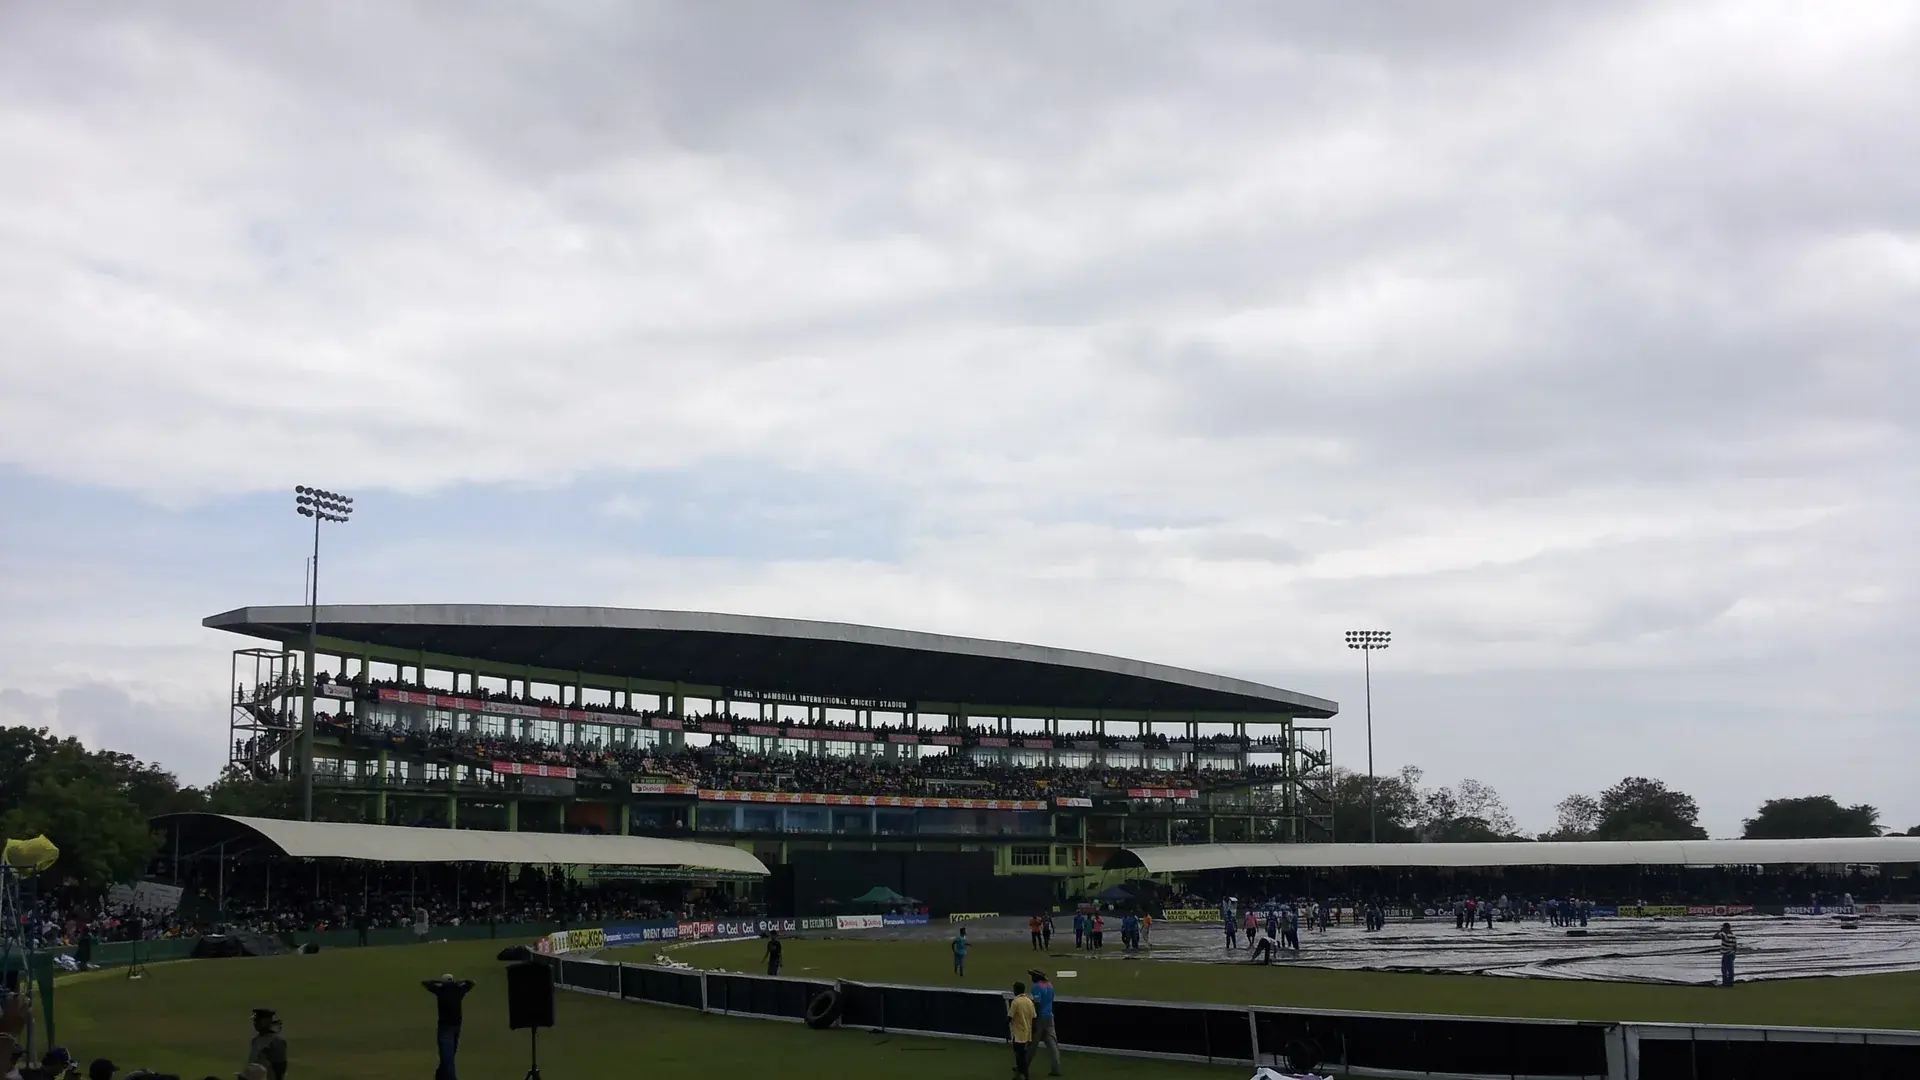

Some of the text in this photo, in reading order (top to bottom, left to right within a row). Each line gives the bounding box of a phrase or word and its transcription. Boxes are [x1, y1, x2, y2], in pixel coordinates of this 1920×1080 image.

[799, 694, 848, 706] INTERNATIONAL
[850, 698, 877, 708] CRICKET
[880, 700, 907, 709] STADIUM
[825, 918, 834, 928] TEA
[588, 929, 603, 947] KGC
